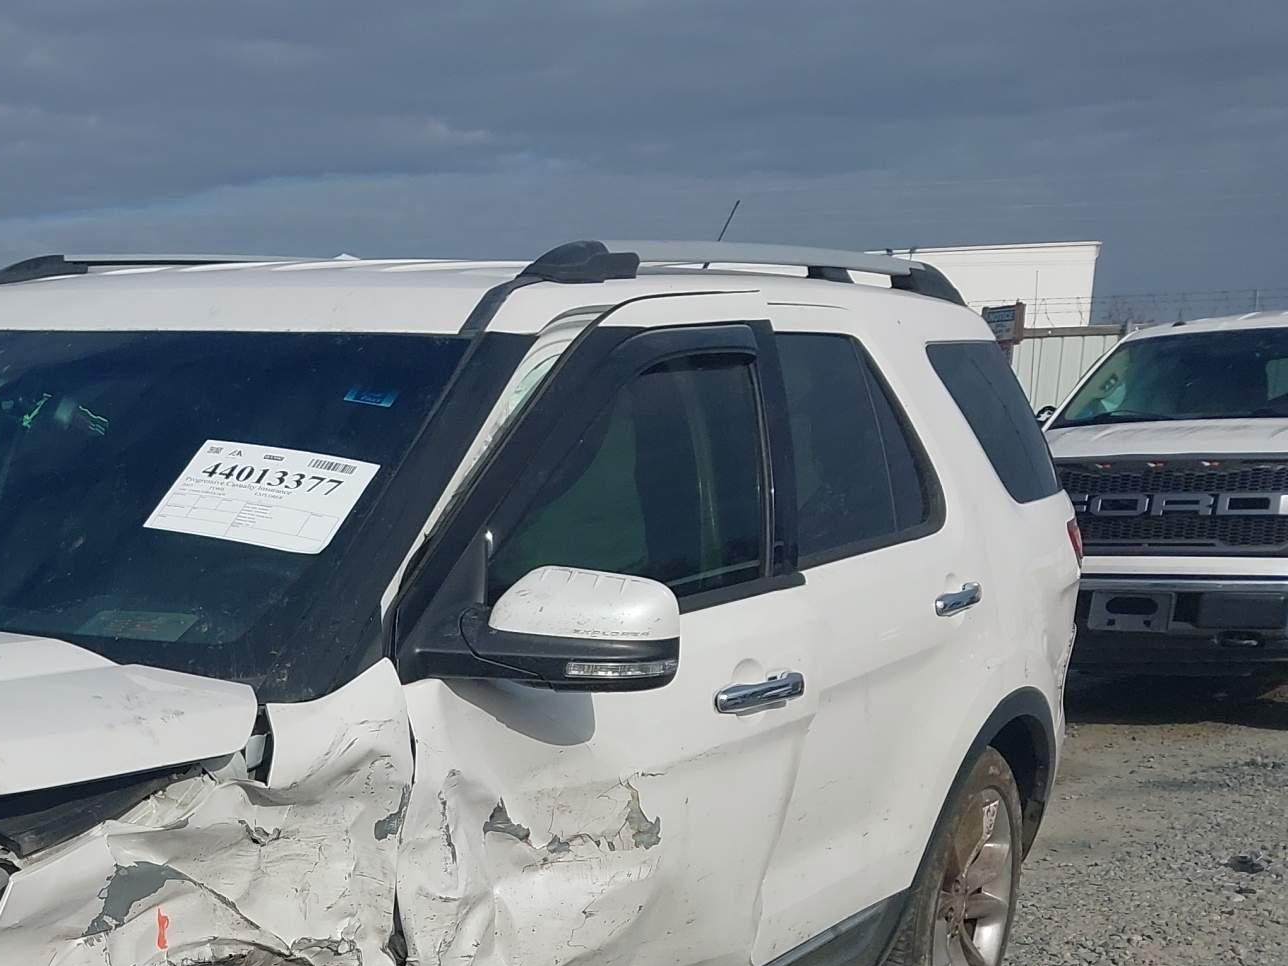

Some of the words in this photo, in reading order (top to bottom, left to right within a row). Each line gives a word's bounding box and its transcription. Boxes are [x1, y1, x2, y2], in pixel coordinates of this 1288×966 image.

[185, 476, 225, 487] Progressive
[226, 481, 257, 491] Casualty
[257, 486, 293, 496] Insurance
[202, 461, 344, 496] 44013377
[572, 628, 651, 638] EXPLORER
